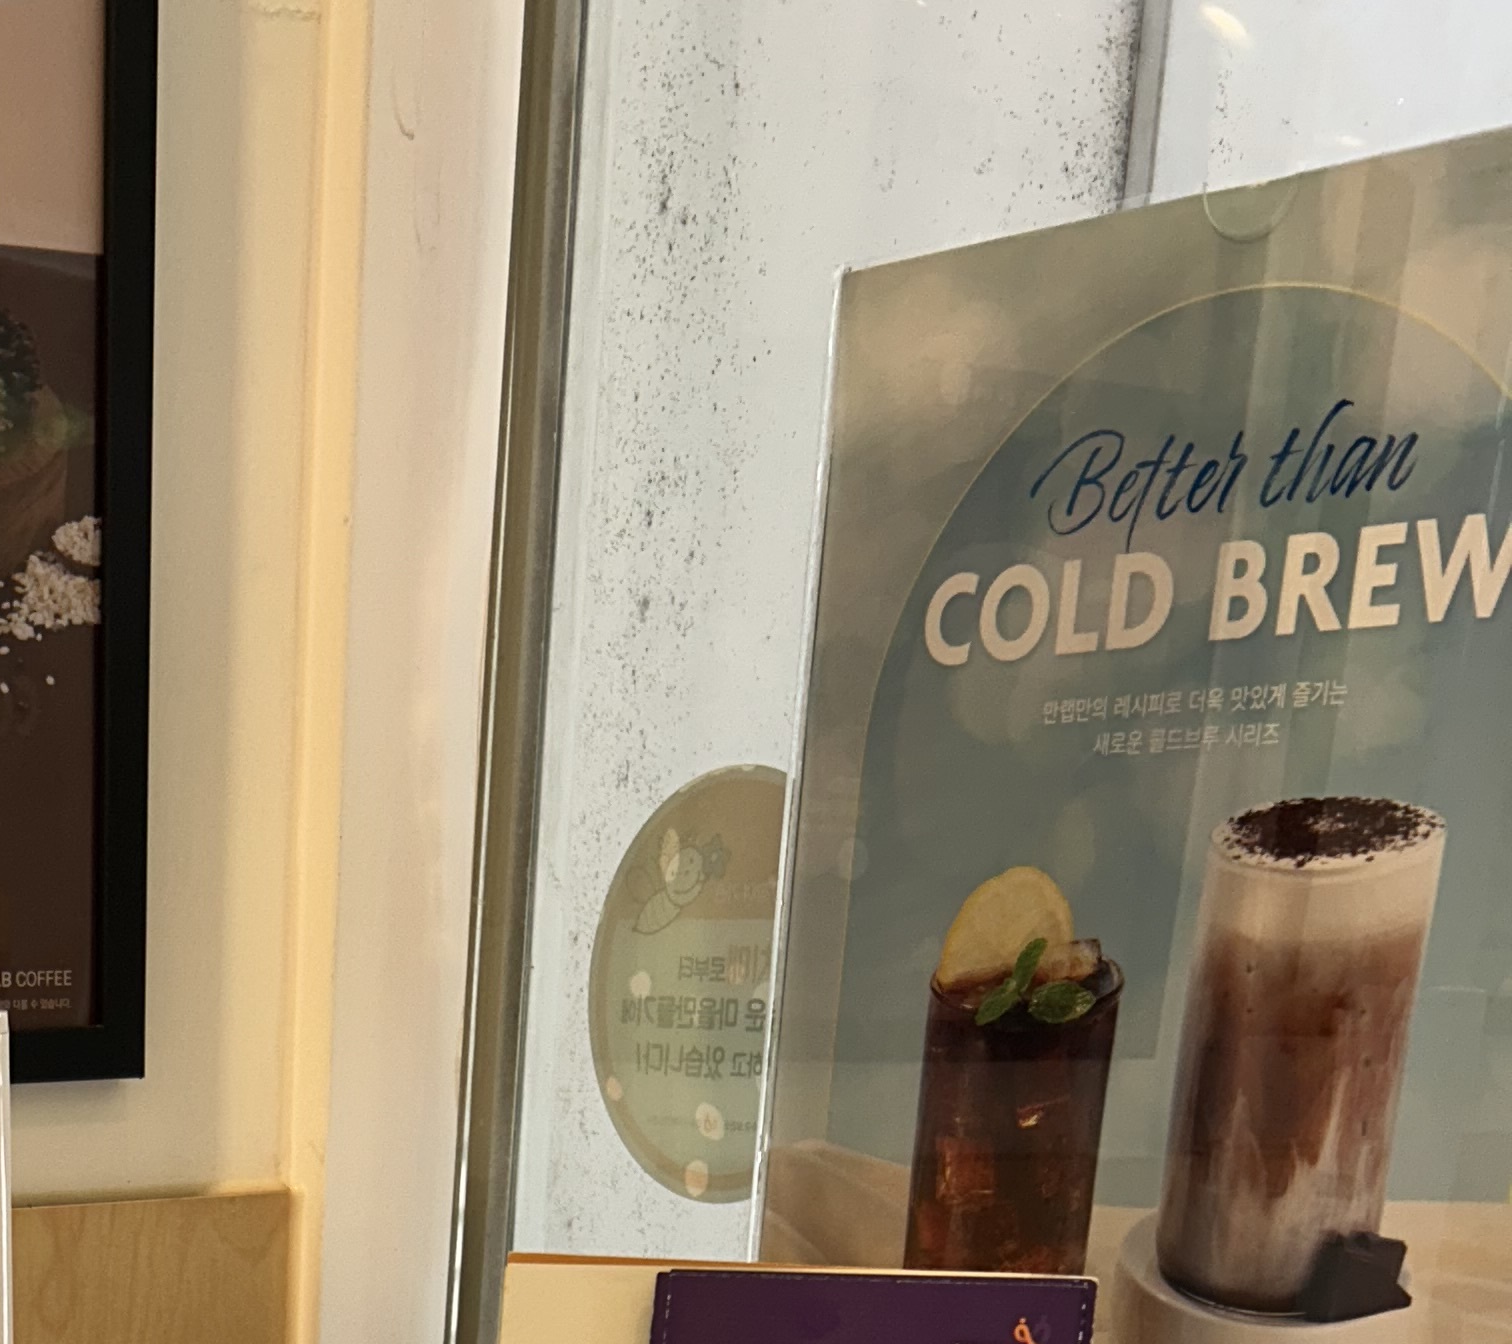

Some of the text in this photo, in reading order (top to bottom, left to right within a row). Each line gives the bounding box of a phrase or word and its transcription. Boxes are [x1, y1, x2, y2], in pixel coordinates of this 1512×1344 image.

[1031, 400, 1419, 553] Better than
[925, 513, 1512, 666] COLD BREW
[1114, 691, 1182, 719] 레시피로
[1189, 689, 1223, 712] 더욱
[1231, 684, 1287, 712] 맛있게
[1293, 680, 1347, 707] 즐기는
[1094, 723, 1280, 757] 새로운 콜드브루 시리즈
[15, 970, 72, 987] COFFEE
